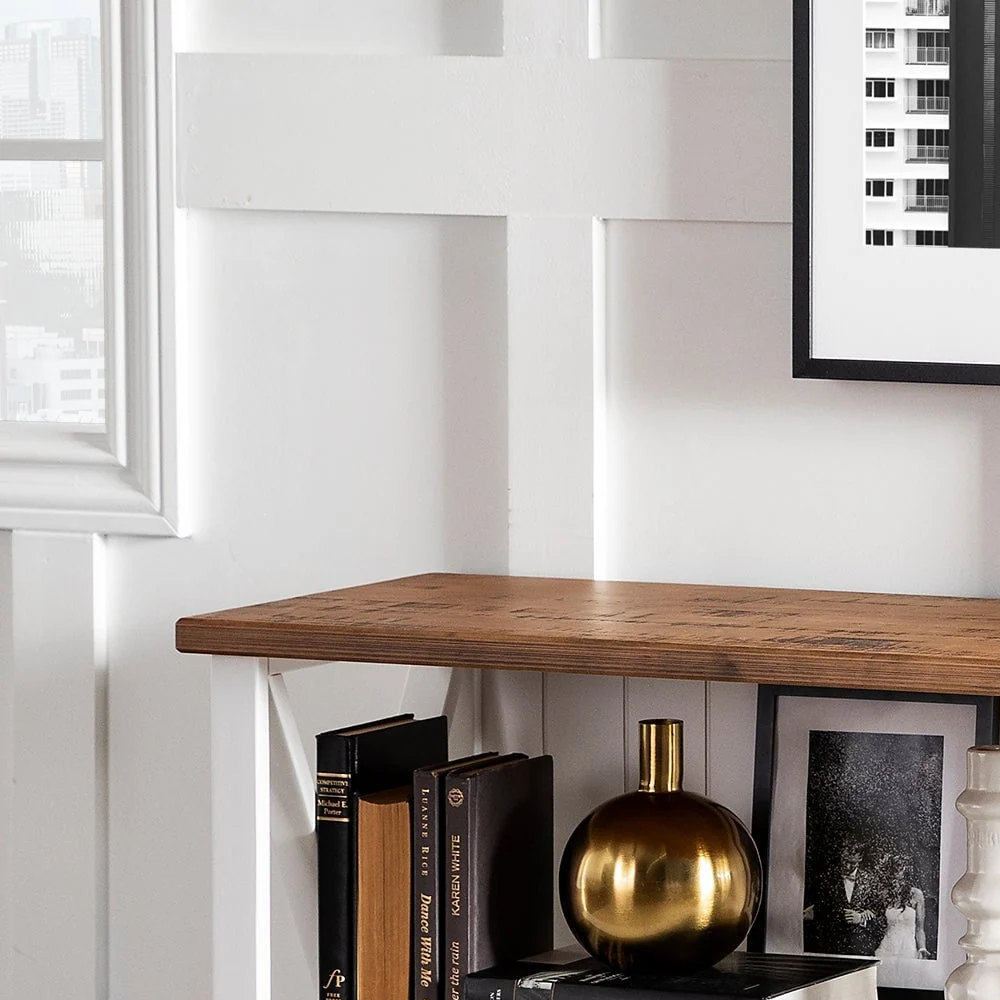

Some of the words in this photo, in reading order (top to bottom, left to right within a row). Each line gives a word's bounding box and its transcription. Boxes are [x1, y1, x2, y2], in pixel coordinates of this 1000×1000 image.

[317, 799, 340, 807] Michael
[421, 788, 430, 838] LUANNE
[421, 846, 430, 876] RICE
[452, 834, 461, 872] WHITE
[452, 874, 461, 916] KAREN
[421, 893, 432, 934] Dance
[421, 937, 432, 965] With
[450, 941, 460, 966] rain
[421, 967, 432, 988] Me
[450, 967, 460, 986] the
